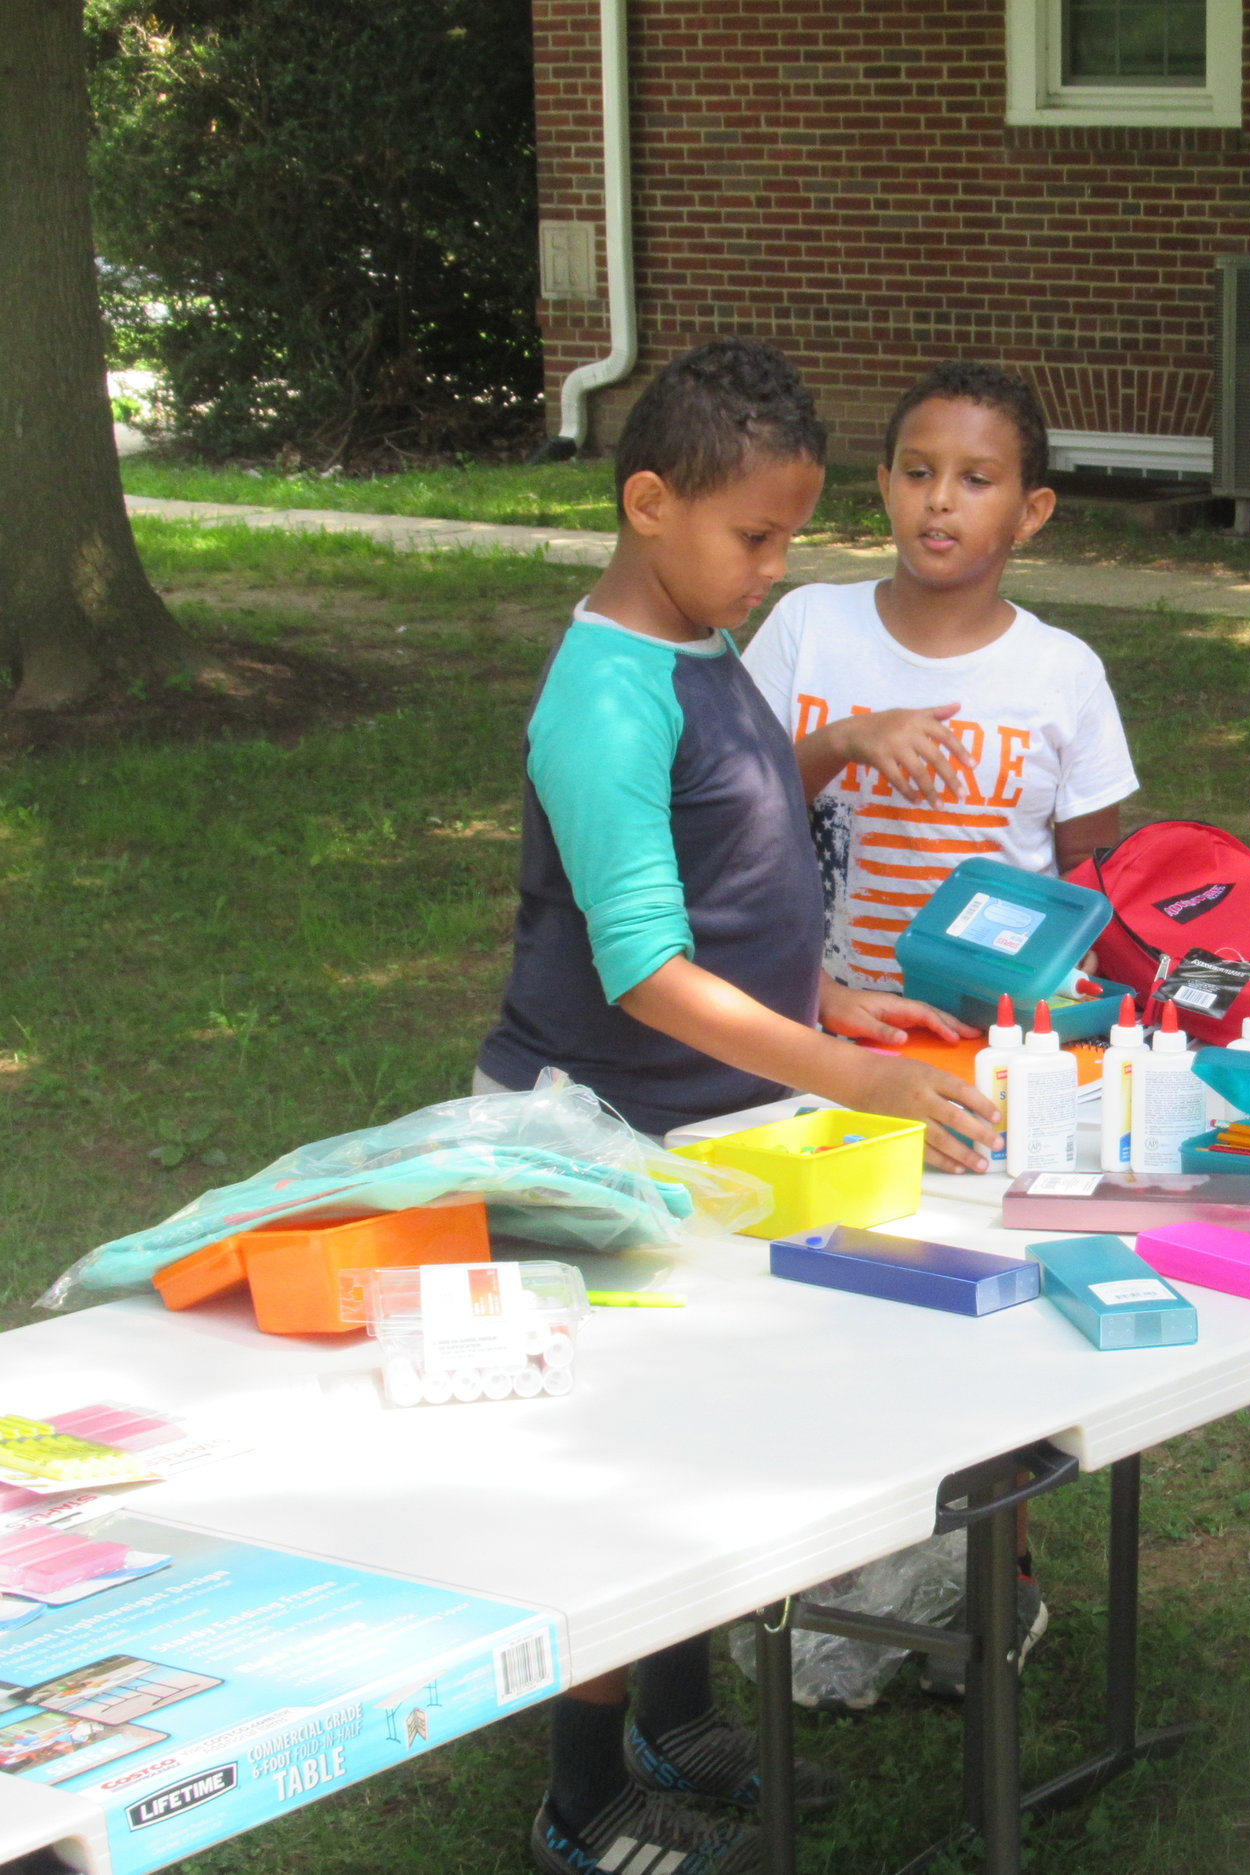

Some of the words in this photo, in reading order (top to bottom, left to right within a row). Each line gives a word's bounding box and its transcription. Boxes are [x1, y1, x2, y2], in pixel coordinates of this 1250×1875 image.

[56, 1591, 164, 1635] Lightweight
[164, 1568, 231, 1594] Design
[148, 1626, 215, 1653] Sturdy
[210, 1600, 282, 1629] Folding
[277, 1579, 337, 1603] Frame
[248, 1720, 323, 1762] COMMERCIAL
[326, 1702, 364, 1730] GRADE
[101, 1757, 177, 1791] COSTCO
[253, 1751, 294, 1779] 6-FOOT
[274, 1747, 347, 1801] TABLE
[139, 1770, 227, 1823] LIFETIME
